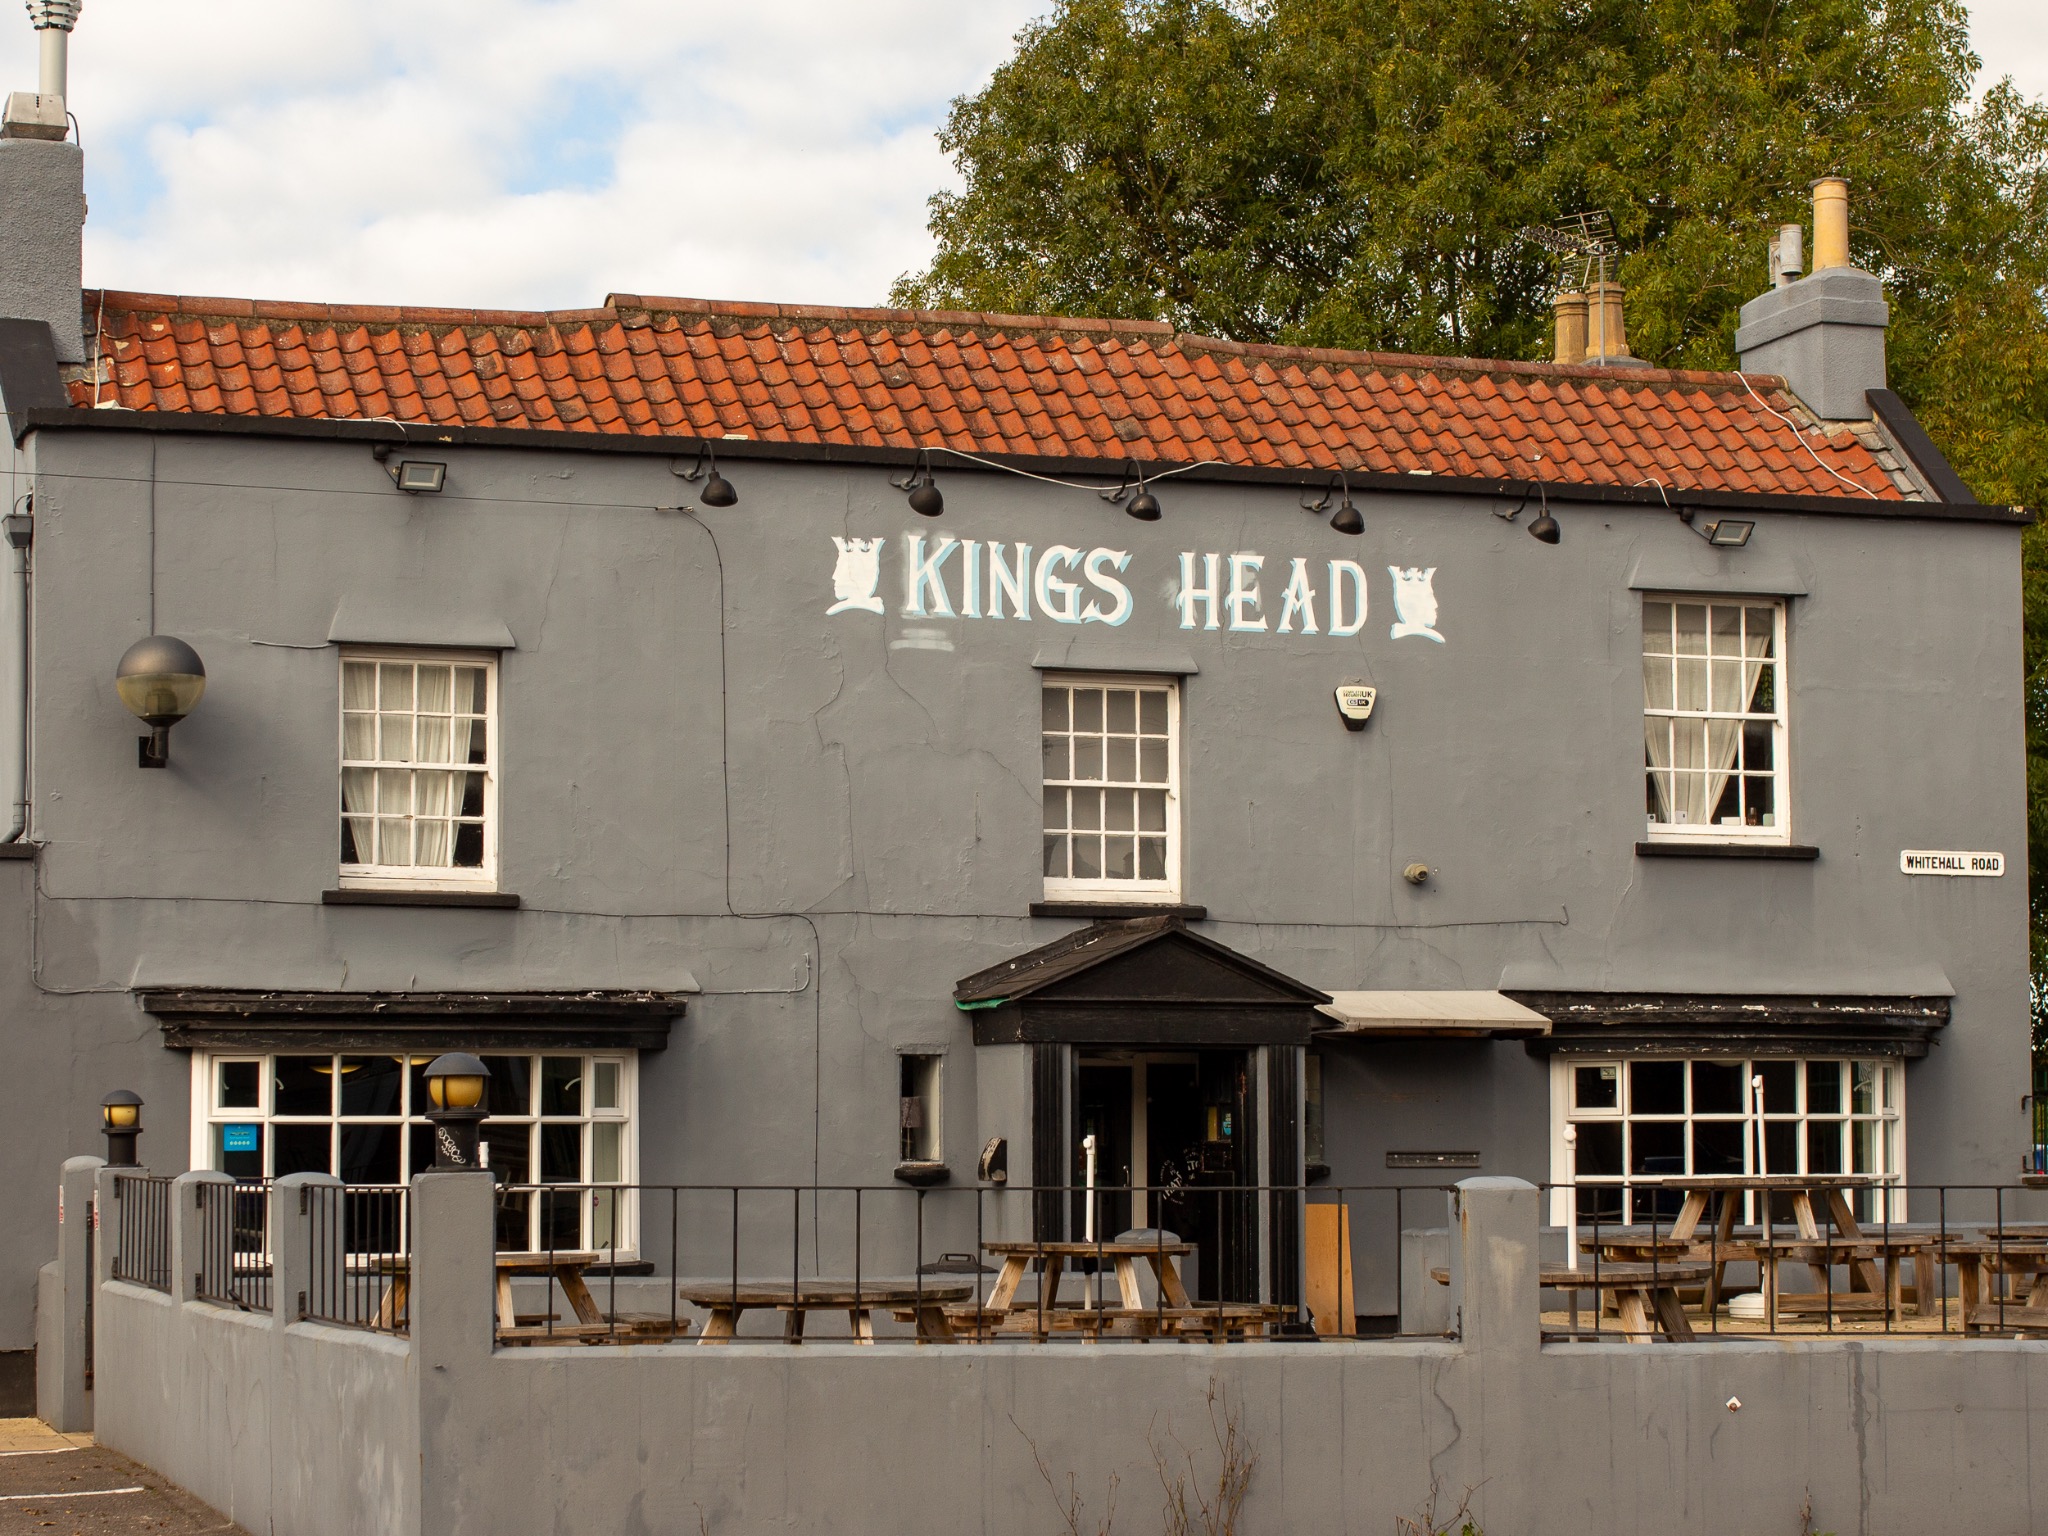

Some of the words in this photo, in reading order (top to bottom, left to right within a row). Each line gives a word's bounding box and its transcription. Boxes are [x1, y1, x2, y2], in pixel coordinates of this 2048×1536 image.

[906, 535, 1134, 627] KINGS
[1176, 551, 1368, 637] HEAD
[1906, 855, 1965, 870] WHITEHALL
[1971, 857, 1999, 870] ROAD
